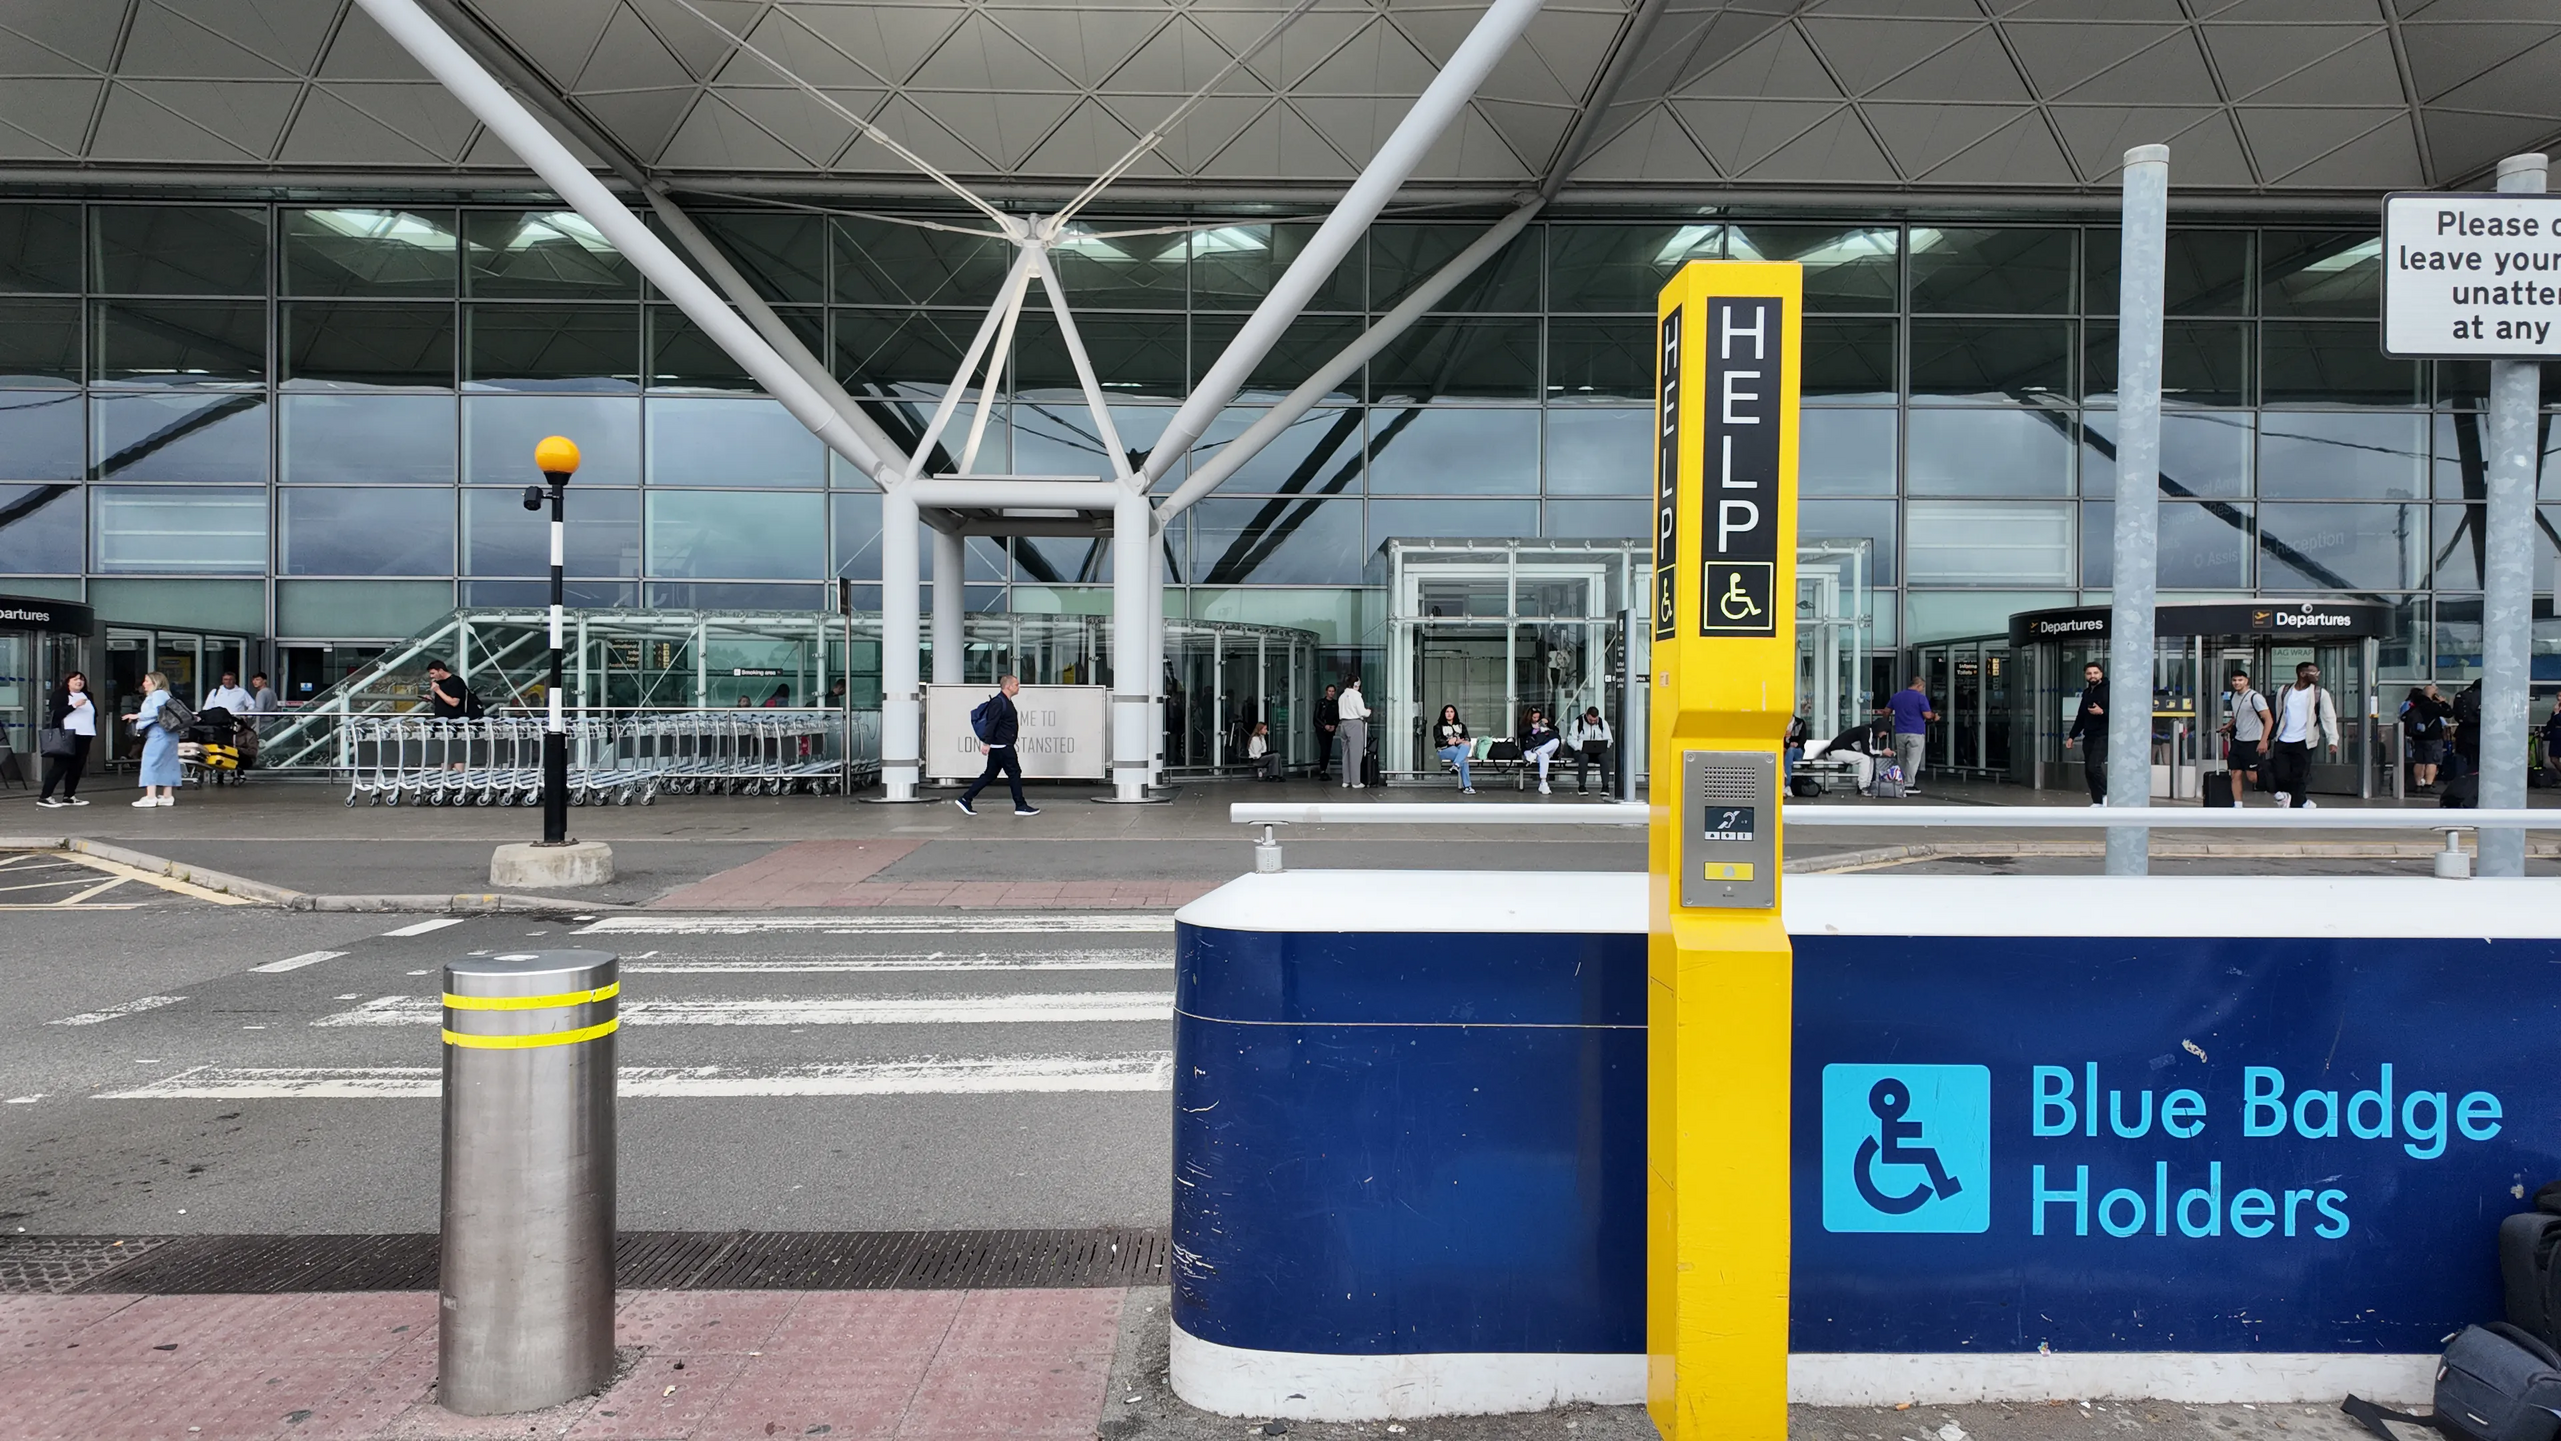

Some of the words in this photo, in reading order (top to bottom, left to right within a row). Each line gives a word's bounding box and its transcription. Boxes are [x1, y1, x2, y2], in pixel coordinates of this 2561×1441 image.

[2437, 210, 2540, 237] Please
[2399, 244, 2482, 271] leave
[2494, 251, 2561, 276] your
[2452, 280, 2561, 306] unatte
[2452, 314, 2484, 340] at
[2495, 320, 2551, 345] any
[1659, 315, 1679, 561] HELP
[1717, 305, 1766, 553] HELP
[0, 608, 50, 622] partures
[2040, 619, 2104, 635] Departures
[2276, 611, 2352, 629] Departures
[2290, 648, 2314, 657] WRAP
[1041, 710, 1056, 726] TO
[957, 736, 982, 753] LON
[1014, 736, 1076, 754] STANSTED
[2032, 1061, 2207, 1139] Blue
[2243, 1062, 2504, 1160] Badge
[2031, 1161, 2351, 1239] Holders
